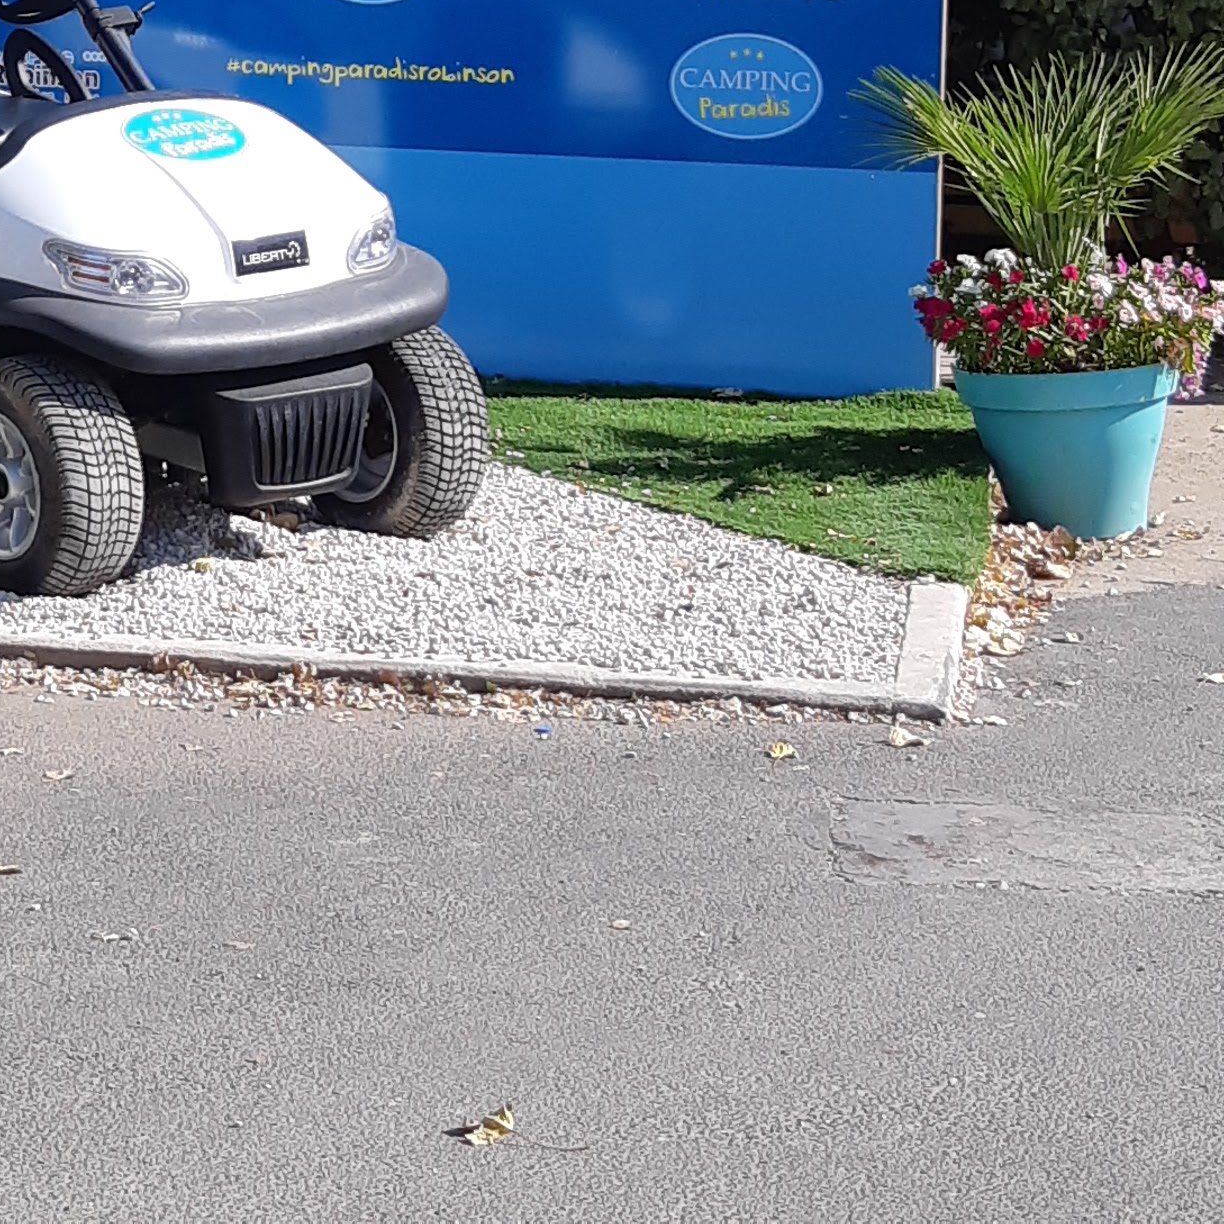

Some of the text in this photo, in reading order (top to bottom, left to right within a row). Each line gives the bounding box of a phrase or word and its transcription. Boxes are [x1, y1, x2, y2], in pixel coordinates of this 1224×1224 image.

[227, 56, 515, 87] #campingparadisrobinson
[680, 68, 811, 92] CAMPING
[699, 94, 790, 119] Paradis
[129, 119, 234, 144] CAMPING
[242, 247, 295, 266] LIBERTY
